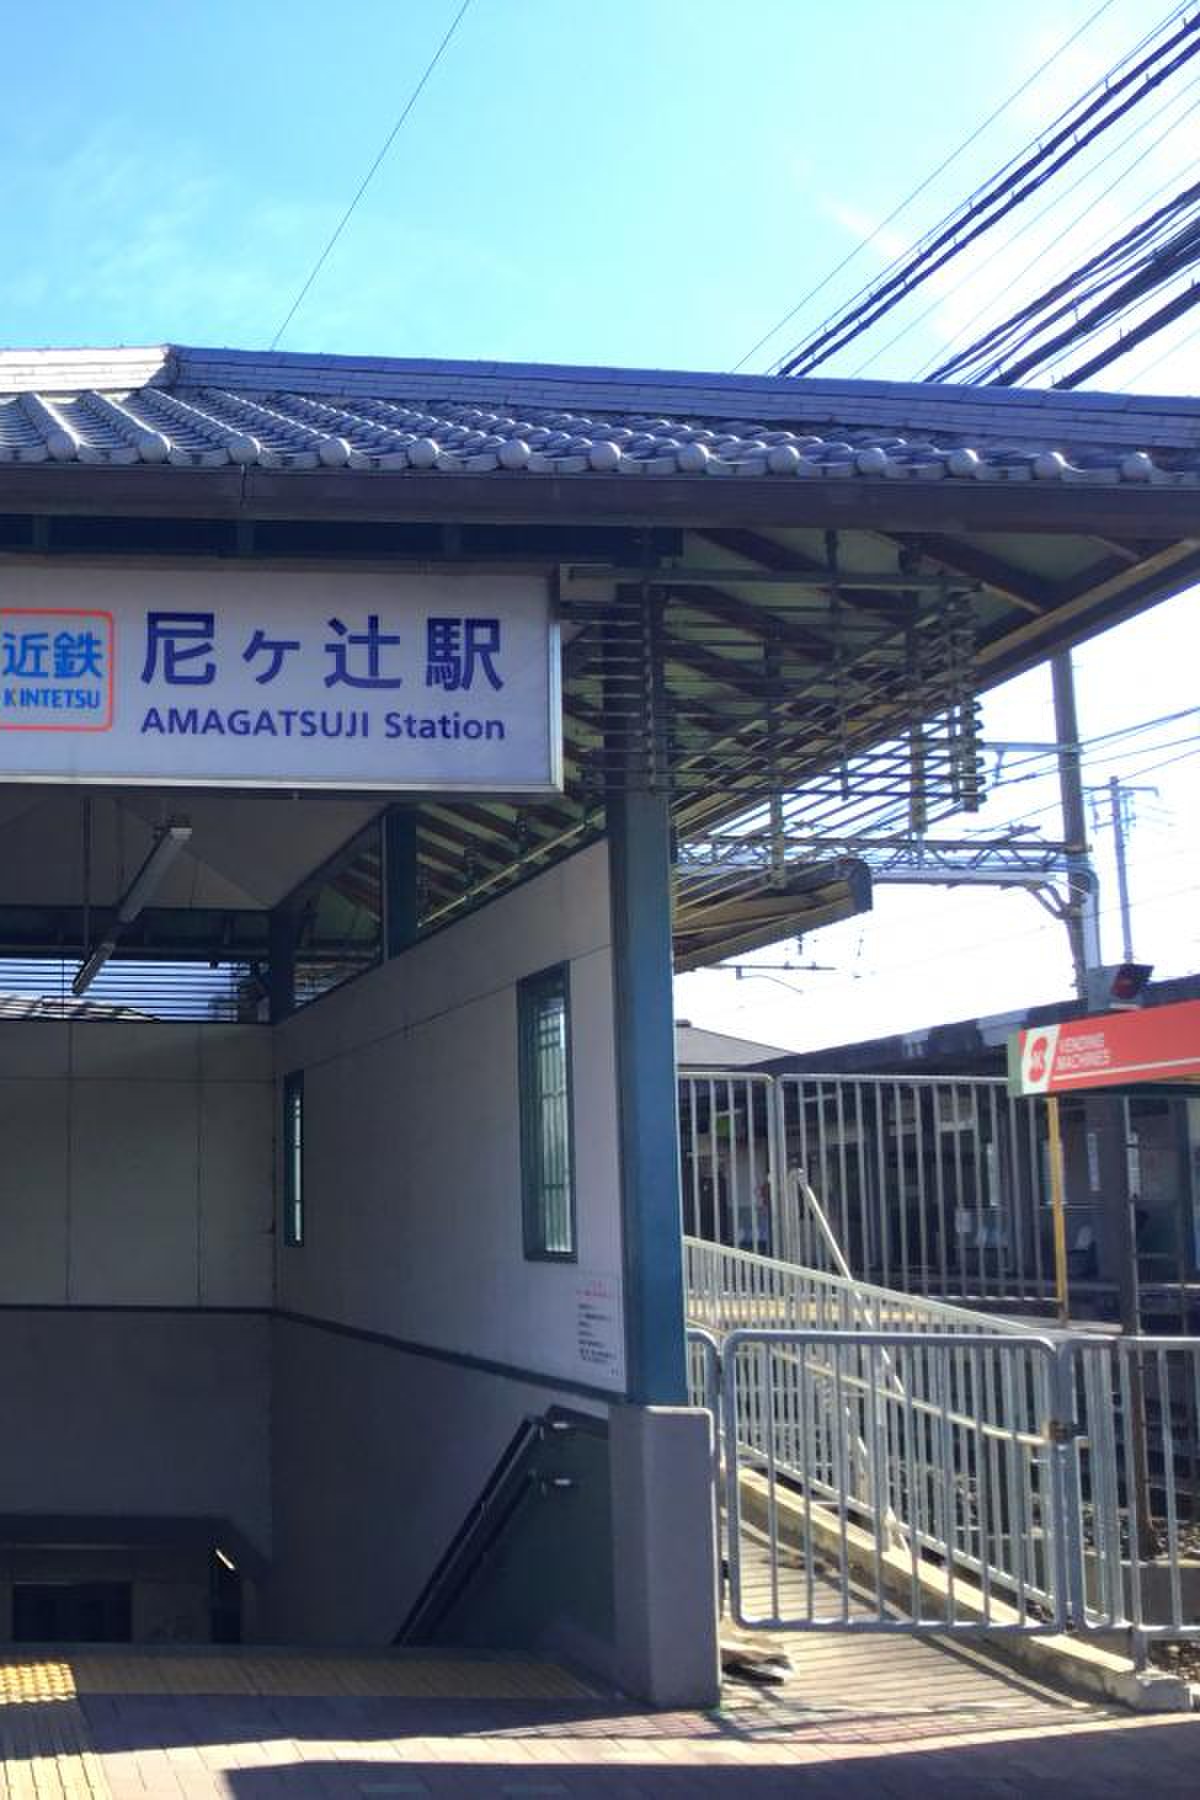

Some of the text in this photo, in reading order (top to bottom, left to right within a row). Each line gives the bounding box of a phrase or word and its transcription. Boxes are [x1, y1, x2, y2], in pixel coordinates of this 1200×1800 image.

[0, 631, 104, 680] 近鉄
[2, 688, 102, 711] KINTETSU
[141, 706, 506, 741] AMAGATSUJI Station
